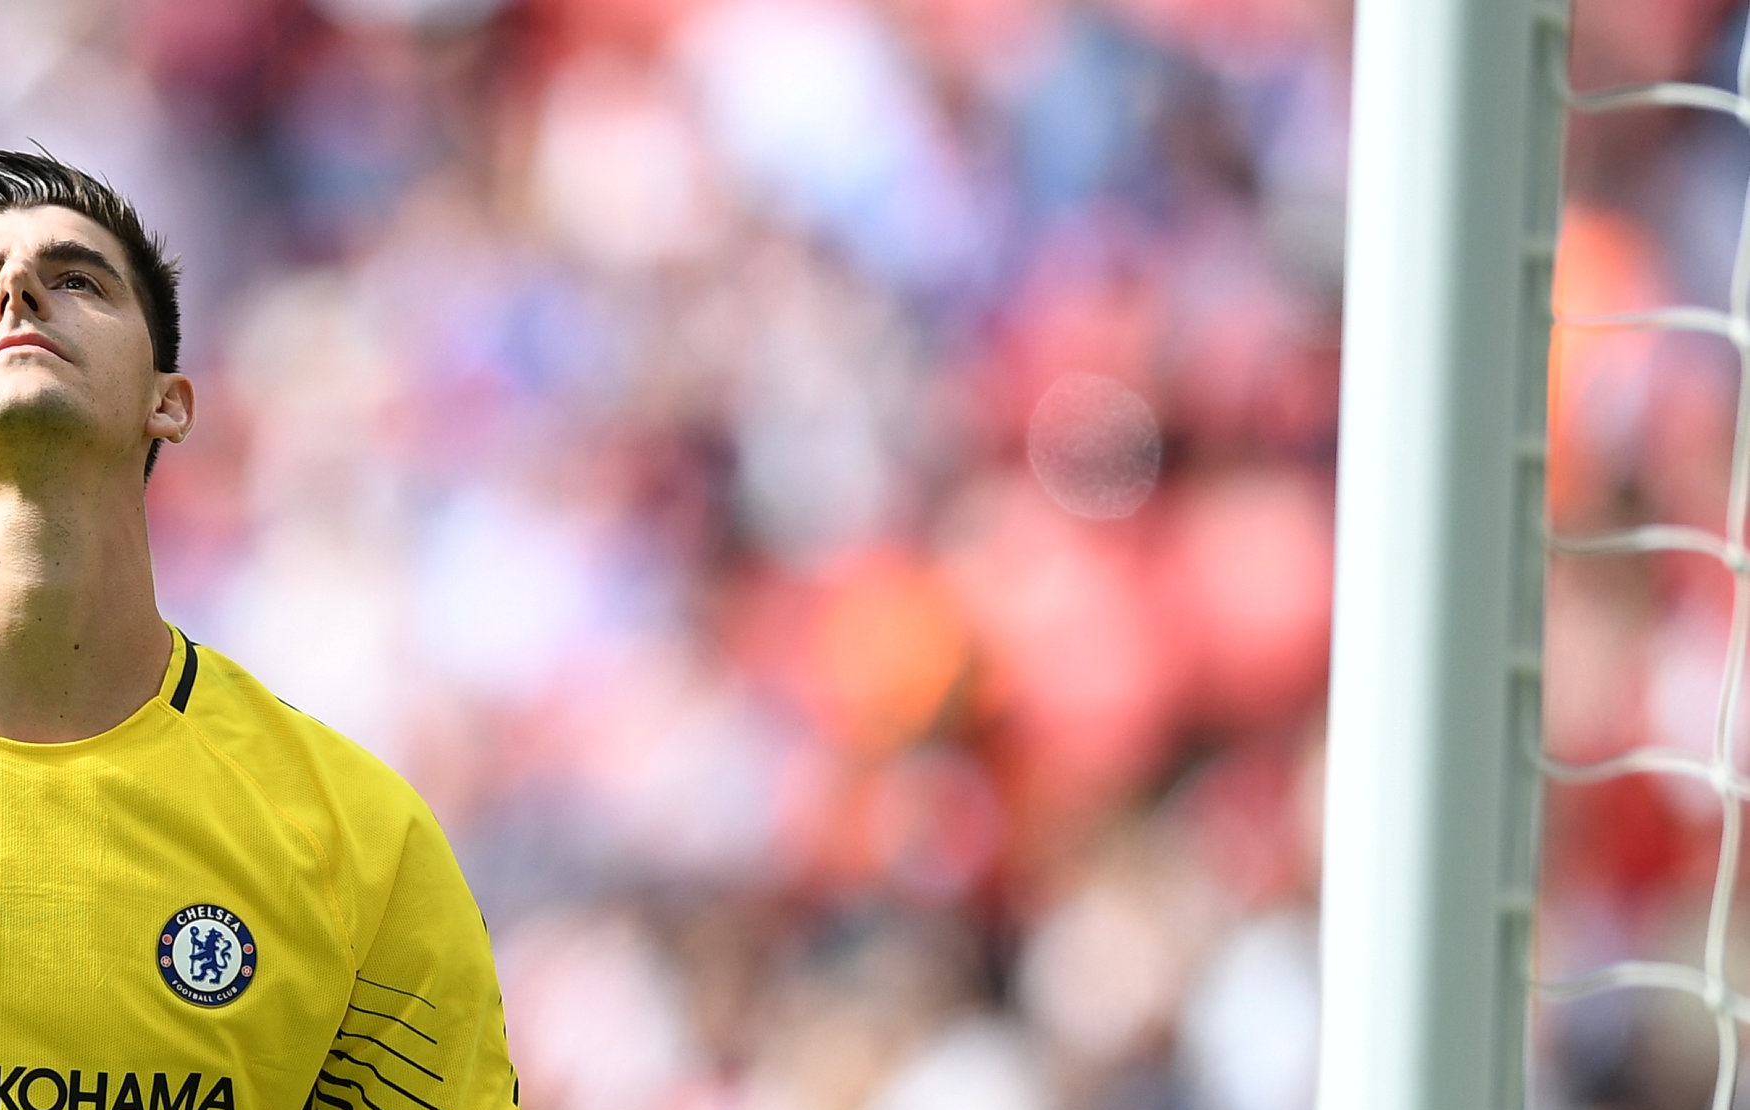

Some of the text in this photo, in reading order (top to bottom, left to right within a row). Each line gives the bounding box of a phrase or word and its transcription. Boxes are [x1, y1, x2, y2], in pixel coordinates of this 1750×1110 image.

[176, 906, 241, 933] CHELSEA
[171, 980, 238, 1002] FOOTBALL CLUB
